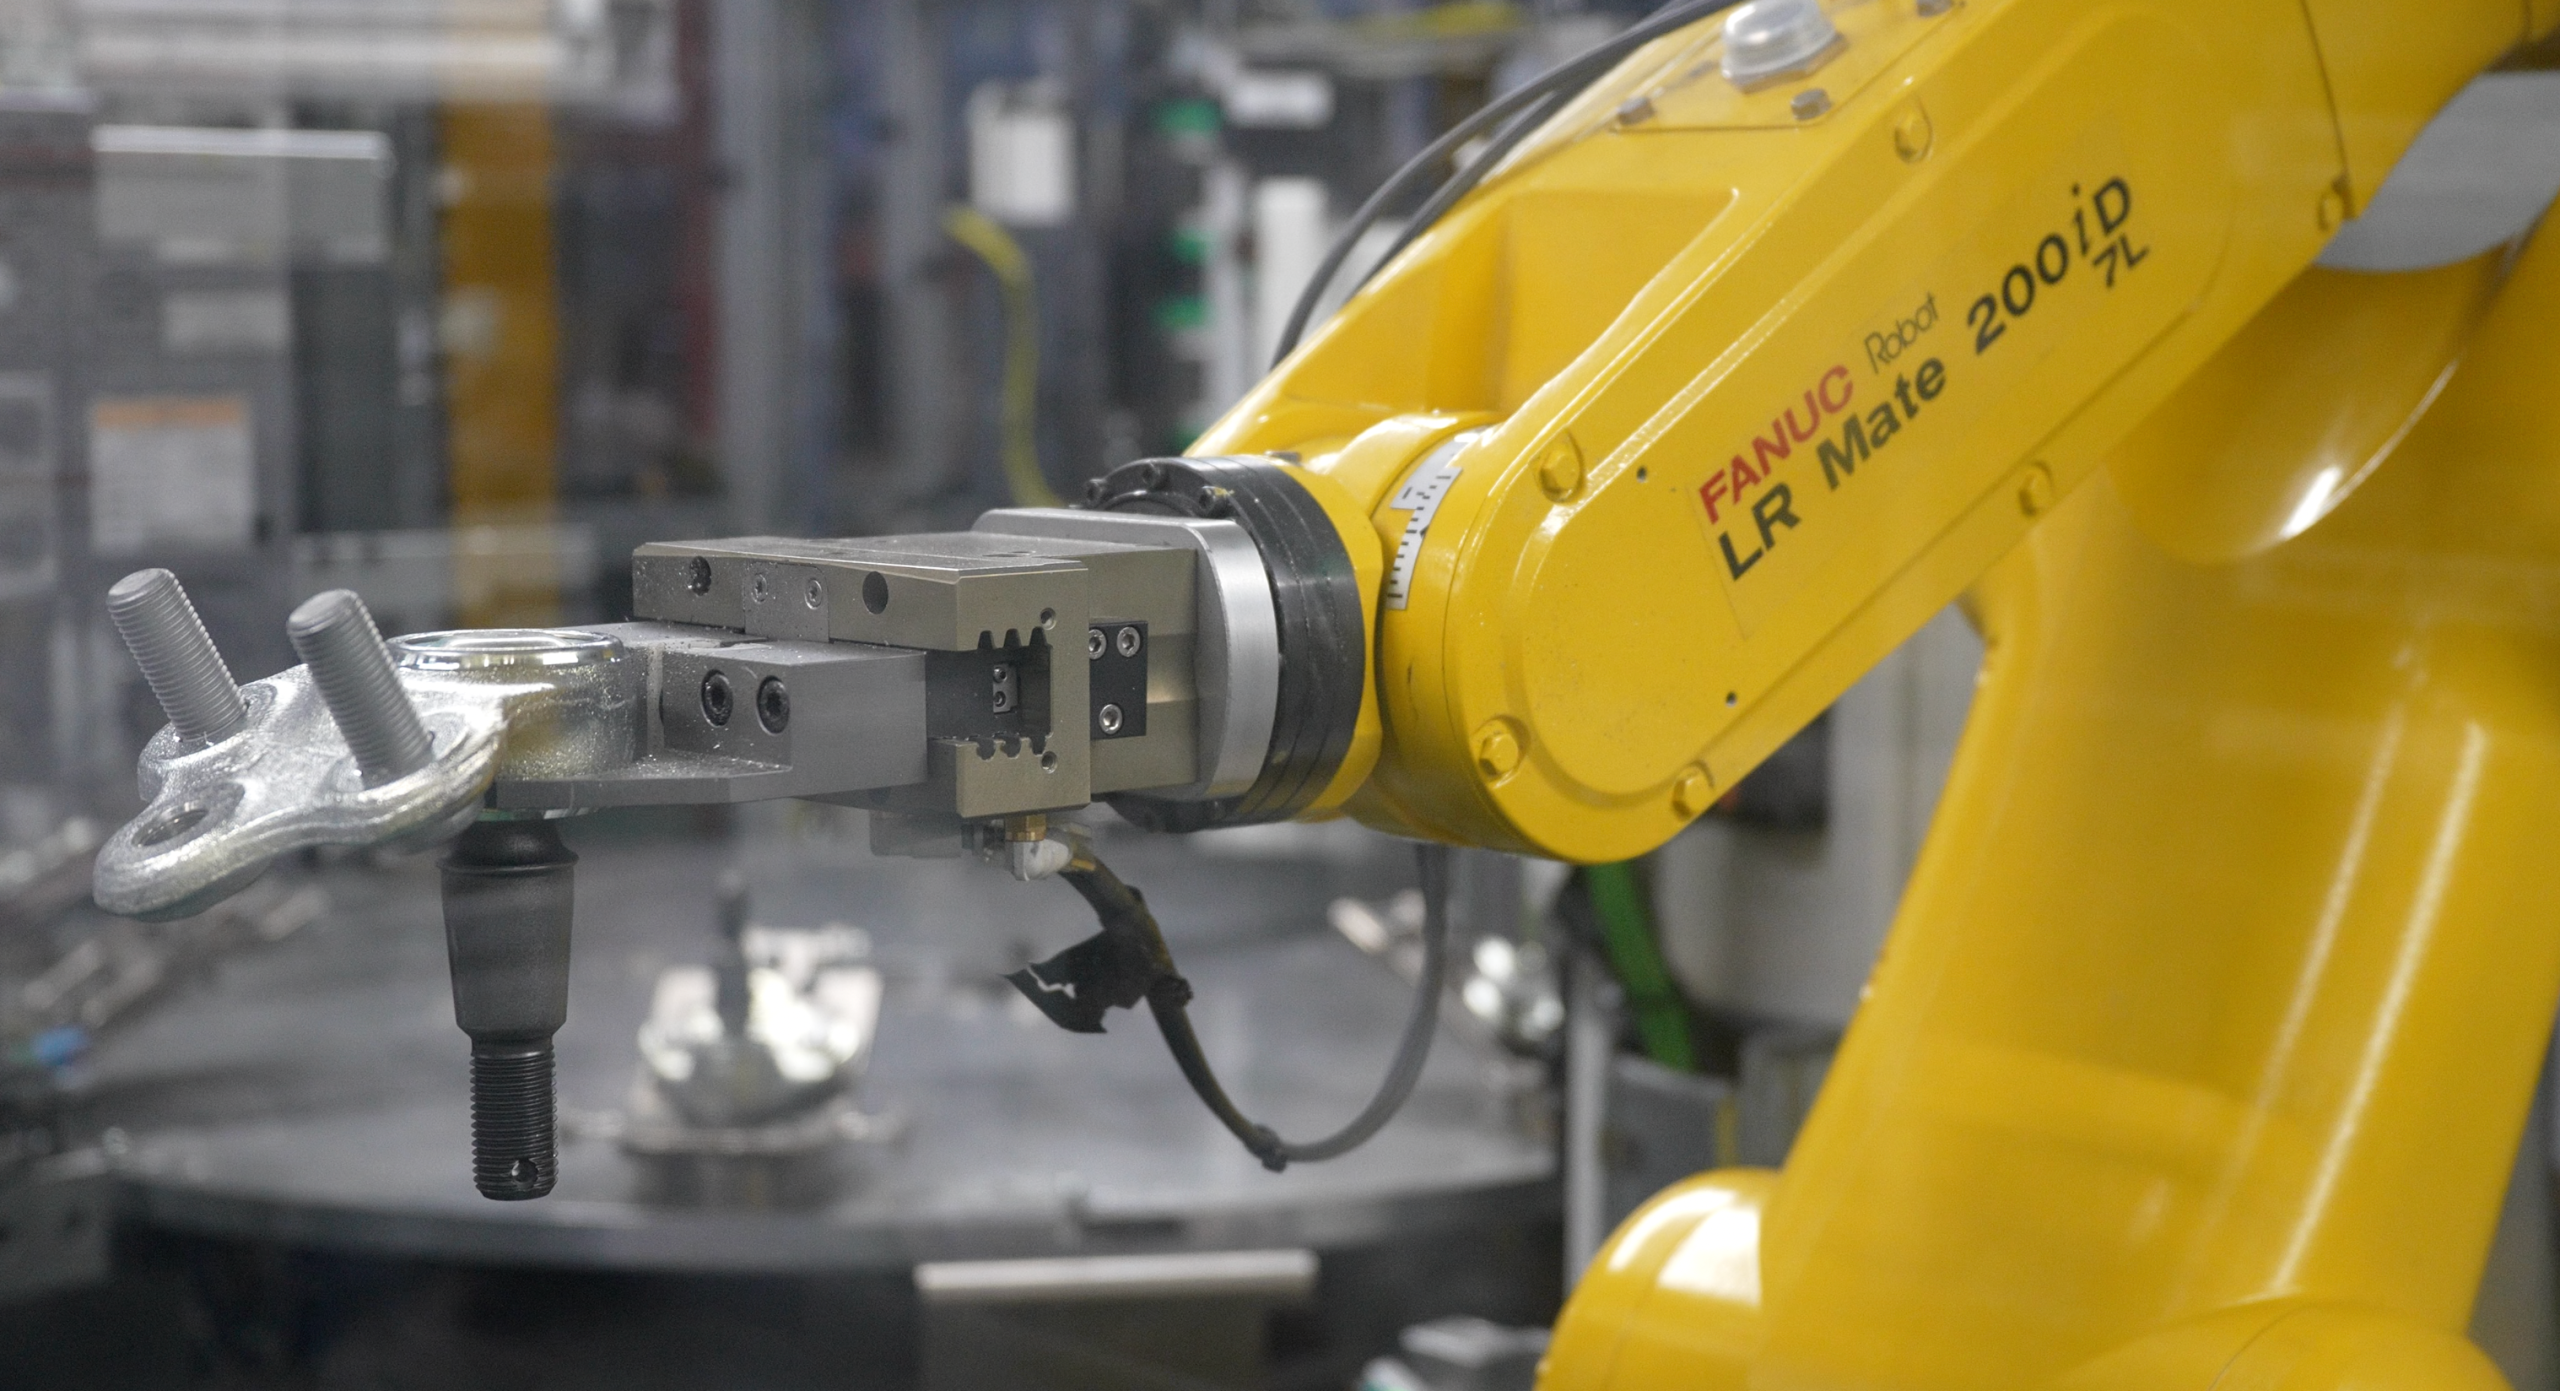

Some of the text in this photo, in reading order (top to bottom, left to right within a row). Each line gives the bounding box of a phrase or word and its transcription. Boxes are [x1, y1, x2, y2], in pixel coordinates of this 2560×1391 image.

[2092, 235, 2149, 289] 7L
[1700, 291, 1940, 524] FANUC Robot
[1718, 483, 1801, 581] LR
[1815, 357, 1946, 491] Mate
